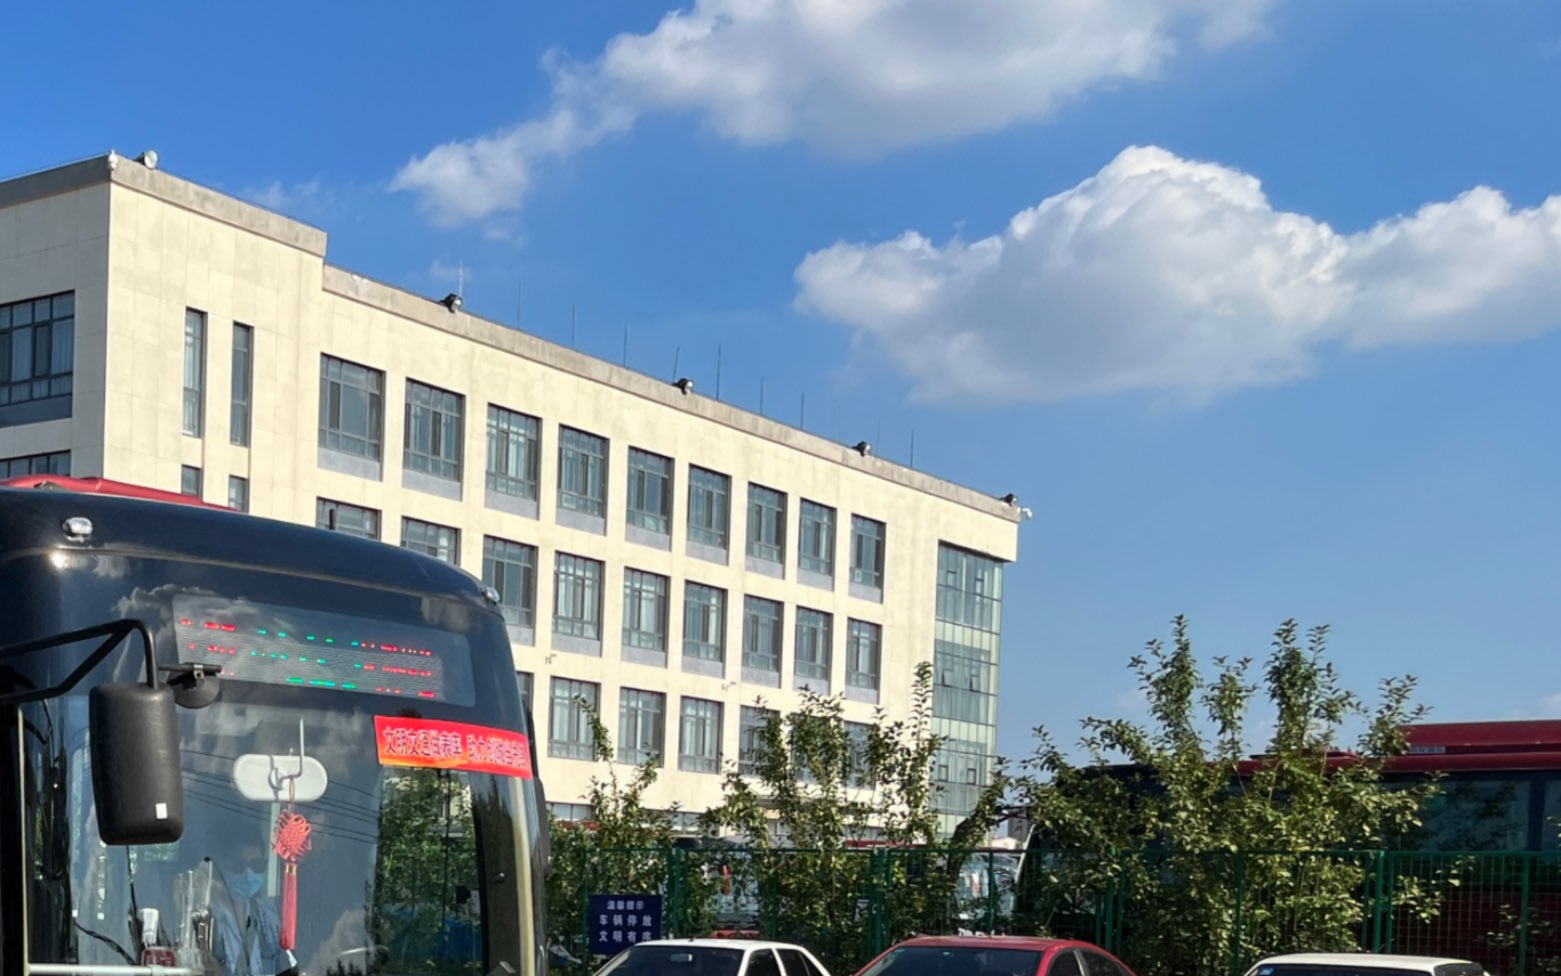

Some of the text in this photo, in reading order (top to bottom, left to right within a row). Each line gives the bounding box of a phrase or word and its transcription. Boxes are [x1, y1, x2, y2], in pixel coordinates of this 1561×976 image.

[607, 900, 645, 911] 温馨提示
[600, 914, 652, 927] 车辆停放
[599, 930, 652, 943] 文明有序
